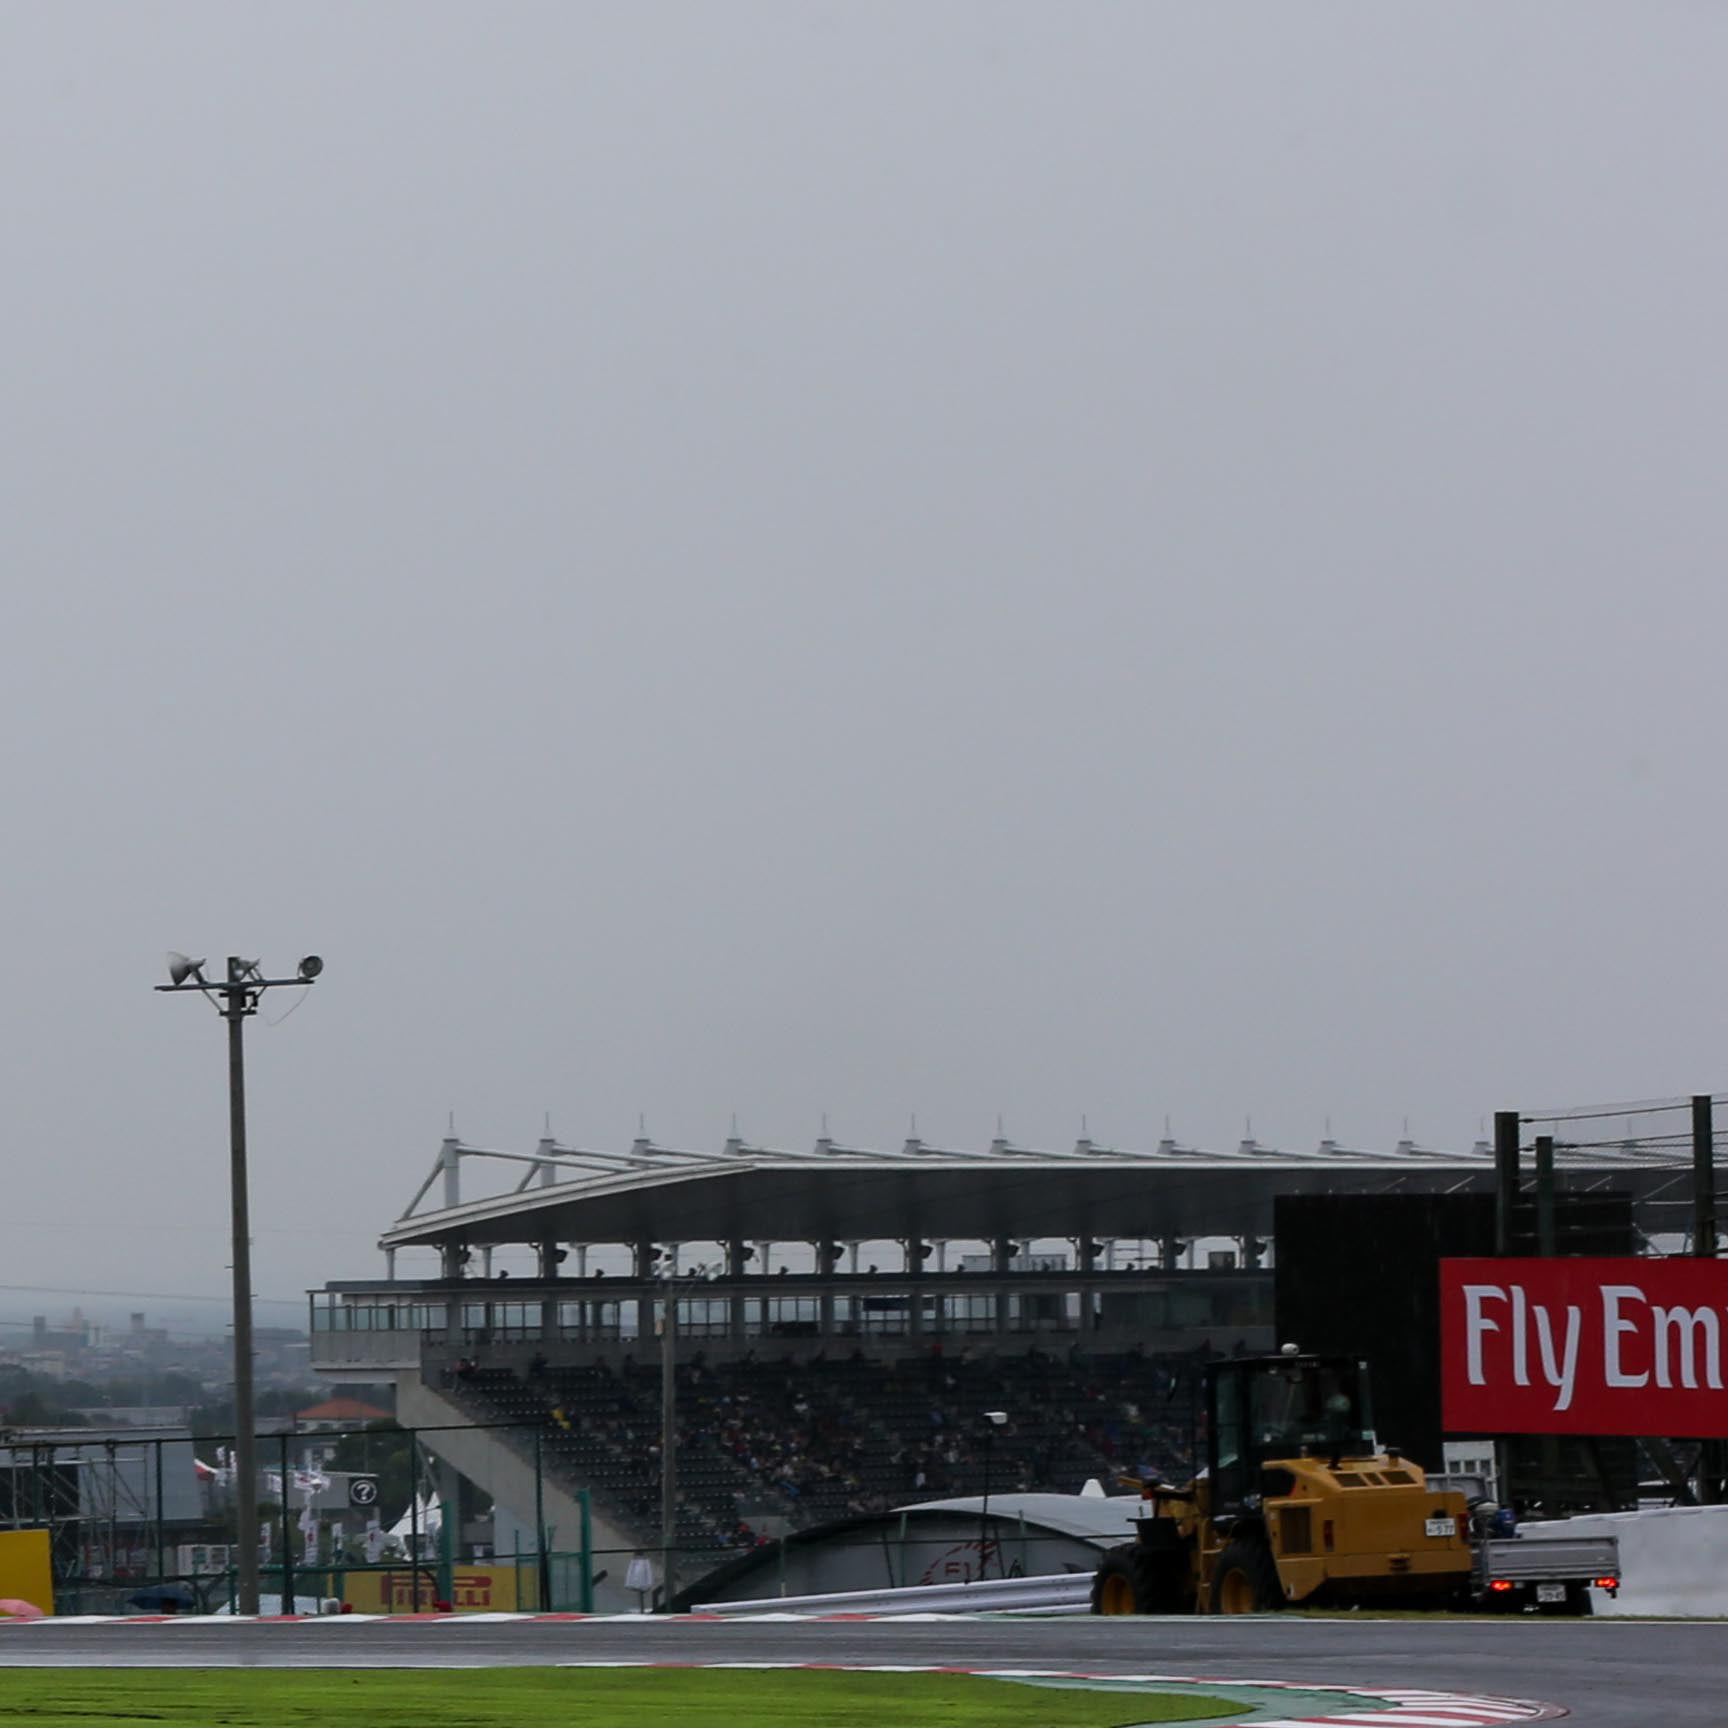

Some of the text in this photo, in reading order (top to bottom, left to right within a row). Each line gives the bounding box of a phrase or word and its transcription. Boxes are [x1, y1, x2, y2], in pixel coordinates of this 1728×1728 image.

[1461, 1284, 1728, 1411] Fly Em
[380, 1575, 493, 1607] PIRLLI
